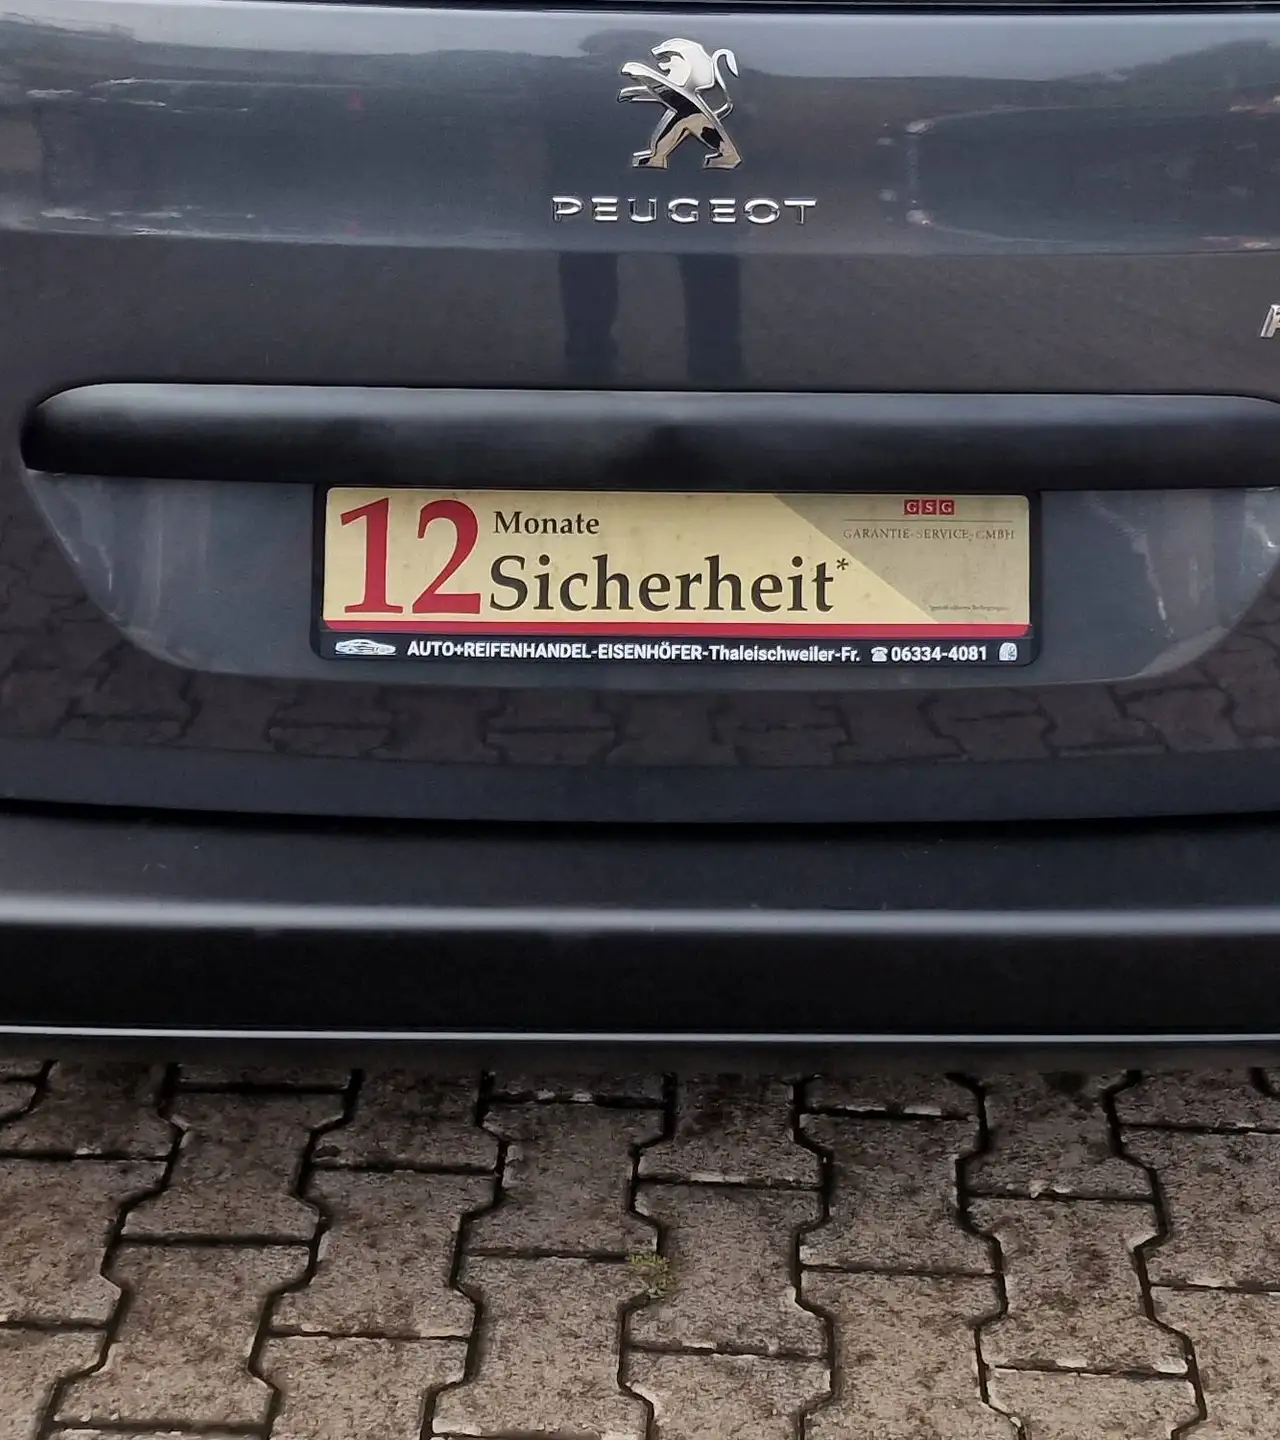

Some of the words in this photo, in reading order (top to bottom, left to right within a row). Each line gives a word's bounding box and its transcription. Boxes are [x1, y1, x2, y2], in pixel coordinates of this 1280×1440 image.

[552, 195, 818, 225] PEUGEOT
[905, 500, 954, 515] GSG
[493, 510, 600, 535] Monate
[340, 497, 481, 614] 12
[891, 645, 987, 662] 06334-4081
